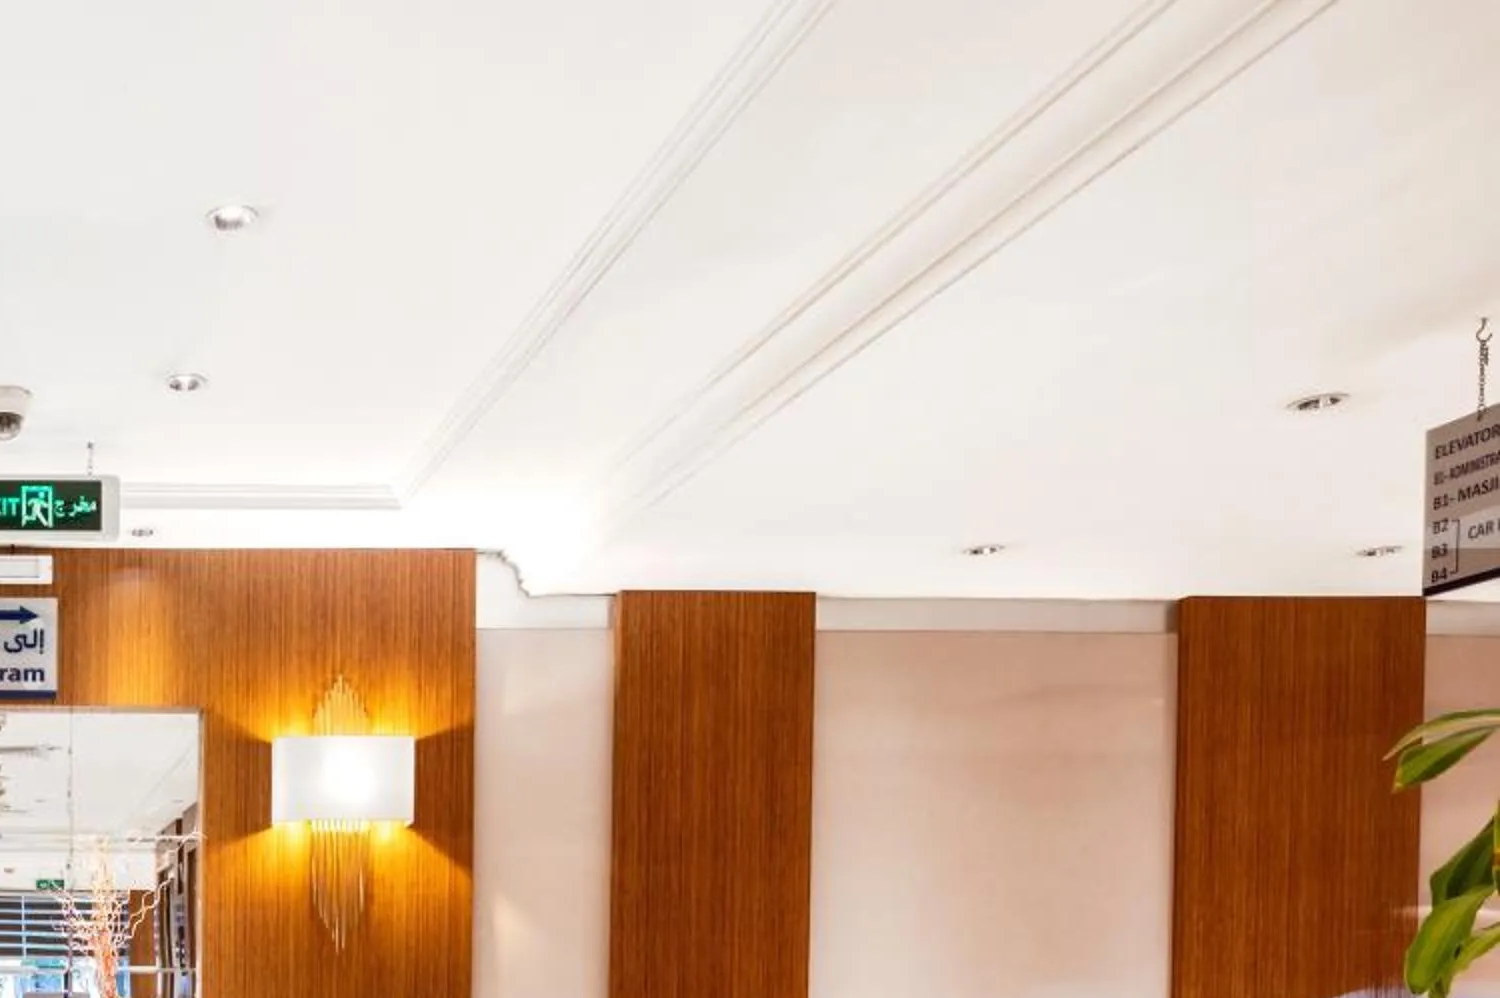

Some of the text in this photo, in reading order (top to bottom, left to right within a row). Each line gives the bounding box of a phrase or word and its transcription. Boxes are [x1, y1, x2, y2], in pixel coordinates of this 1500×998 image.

[1432, 518, 1449, 535] B2
[1467, 518, 1494, 540] CAR
[1430, 543, 1448, 559] B3
[1430, 567, 1448, 584] B4
[3, 628, 45, 655] إلى
